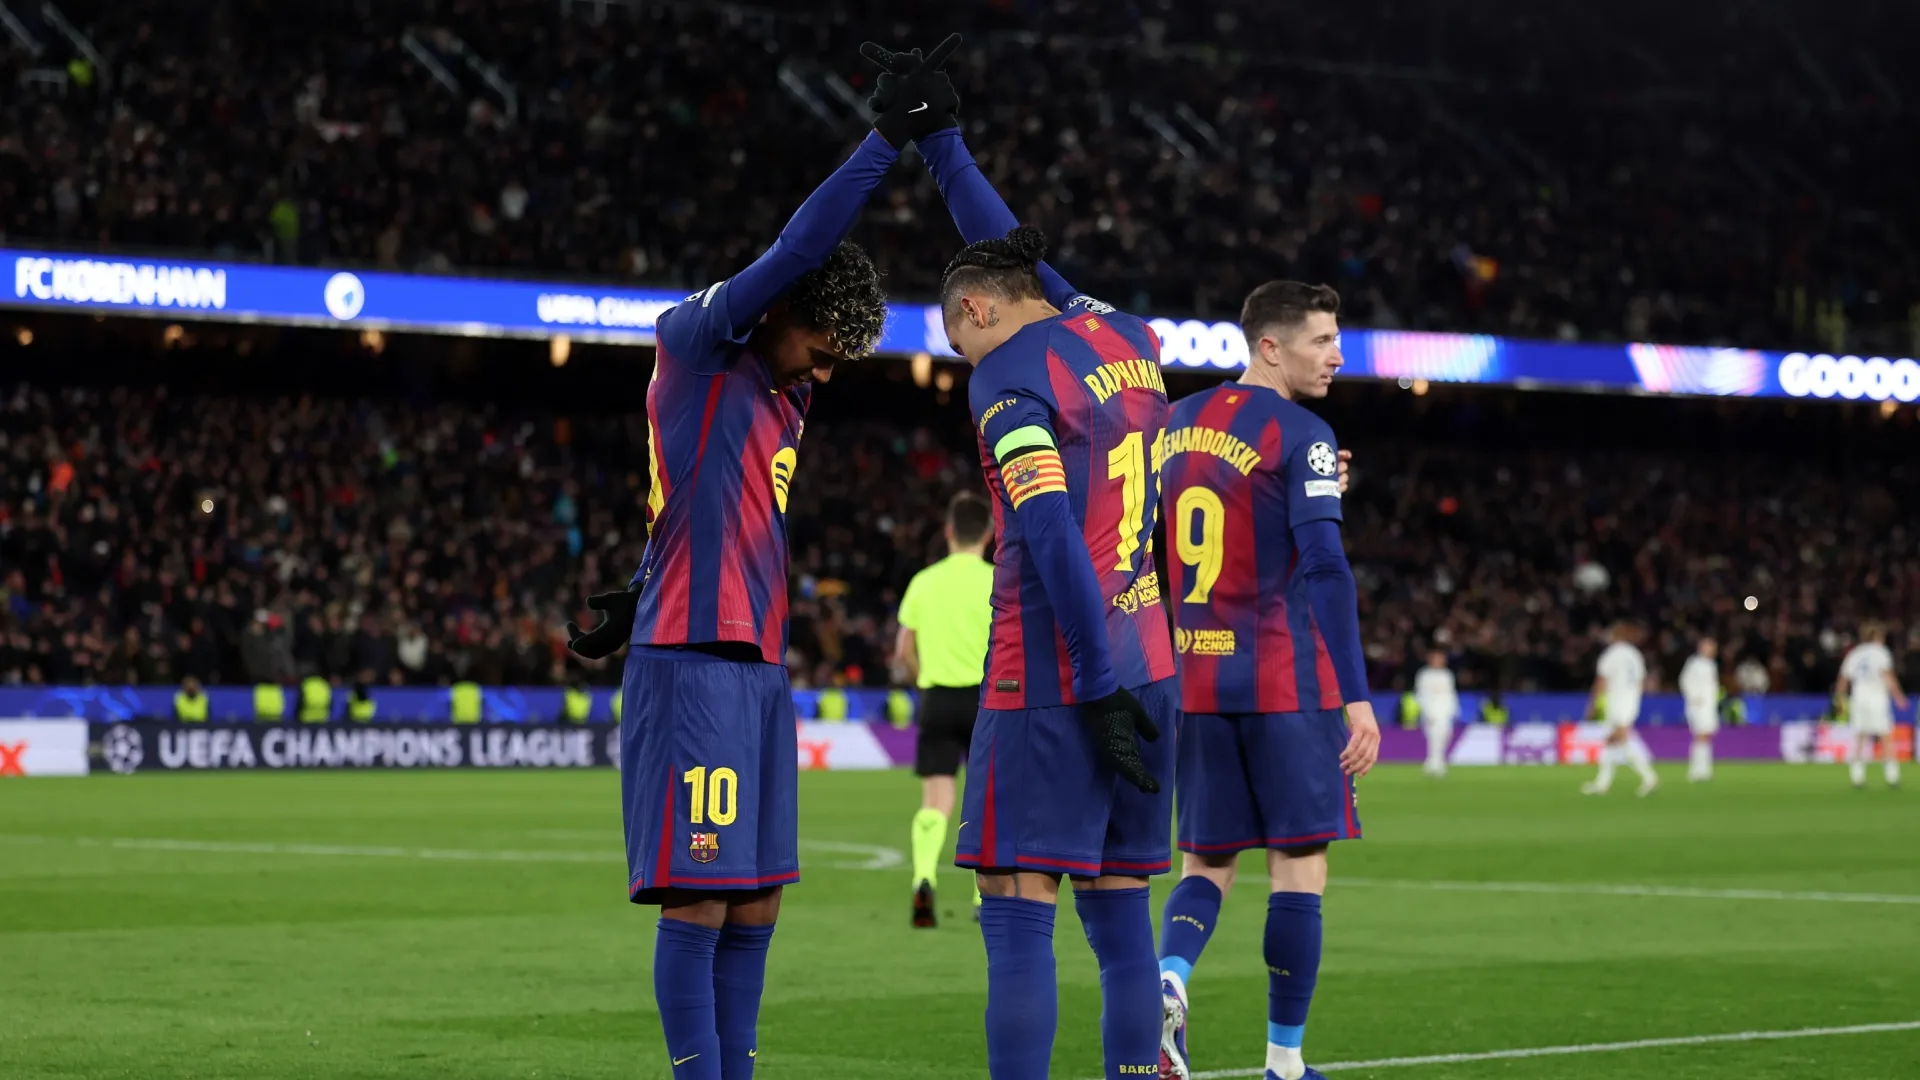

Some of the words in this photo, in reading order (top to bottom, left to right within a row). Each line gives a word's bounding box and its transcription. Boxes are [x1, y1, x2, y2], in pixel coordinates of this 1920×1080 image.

[1148, 317, 1251, 369] OOO
[1778, 352, 1920, 402] GOOOO
[1176, 486, 1225, 604] 9
[1192, 640, 1236, 651] ACNUR
[1194, 629, 1235, 641] UNHCR
[158, 729, 255, 768] UEFA
[260, 728, 463, 767] CHAMPIONS
[469, 729, 595, 767] LEAGUE
[683, 766, 738, 826] 10
[1119, 1064, 1158, 1075] BARÇA
